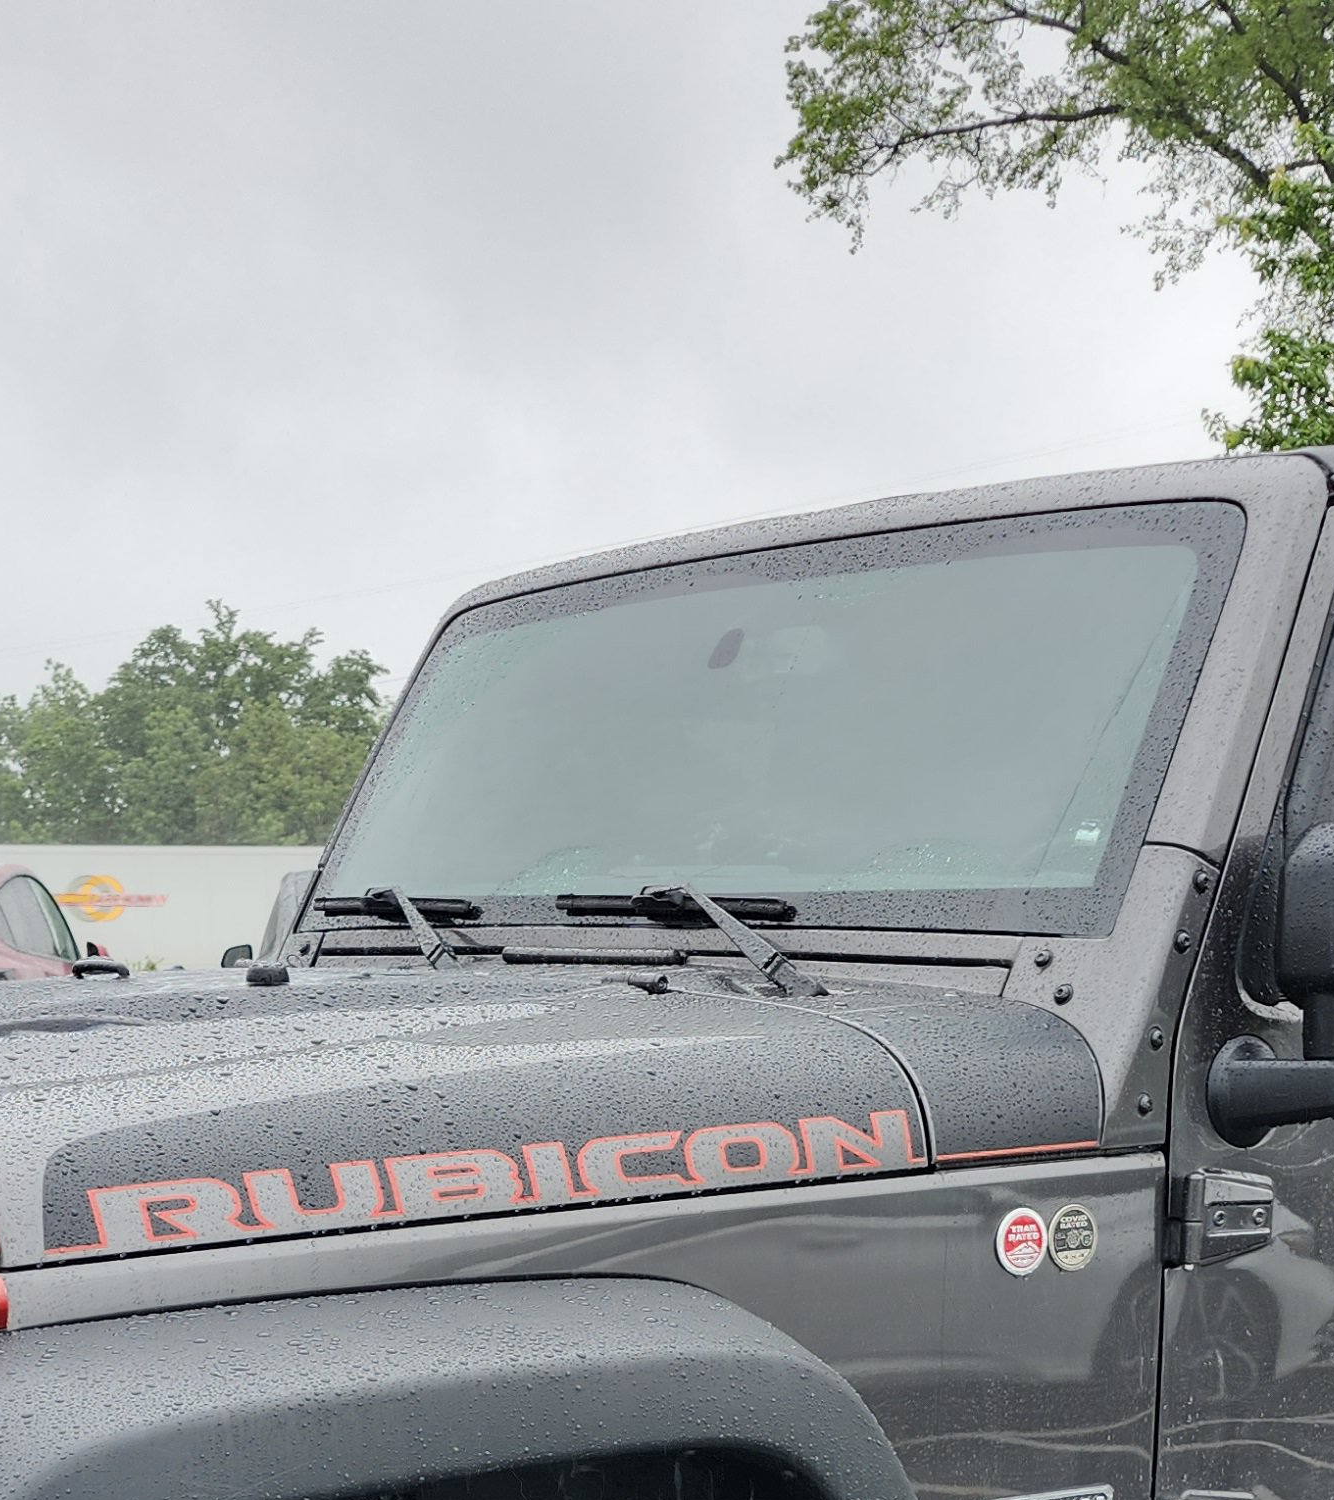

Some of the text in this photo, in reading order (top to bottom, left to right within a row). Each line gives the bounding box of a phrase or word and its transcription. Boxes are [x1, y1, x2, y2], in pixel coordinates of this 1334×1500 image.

[87, 1110, 915, 1256] RUBICON
[1059, 1214, 1087, 1223] COVID
[1059, 1221, 1088, 1229] RATED
[1008, 1232, 1040, 1242] RATED
